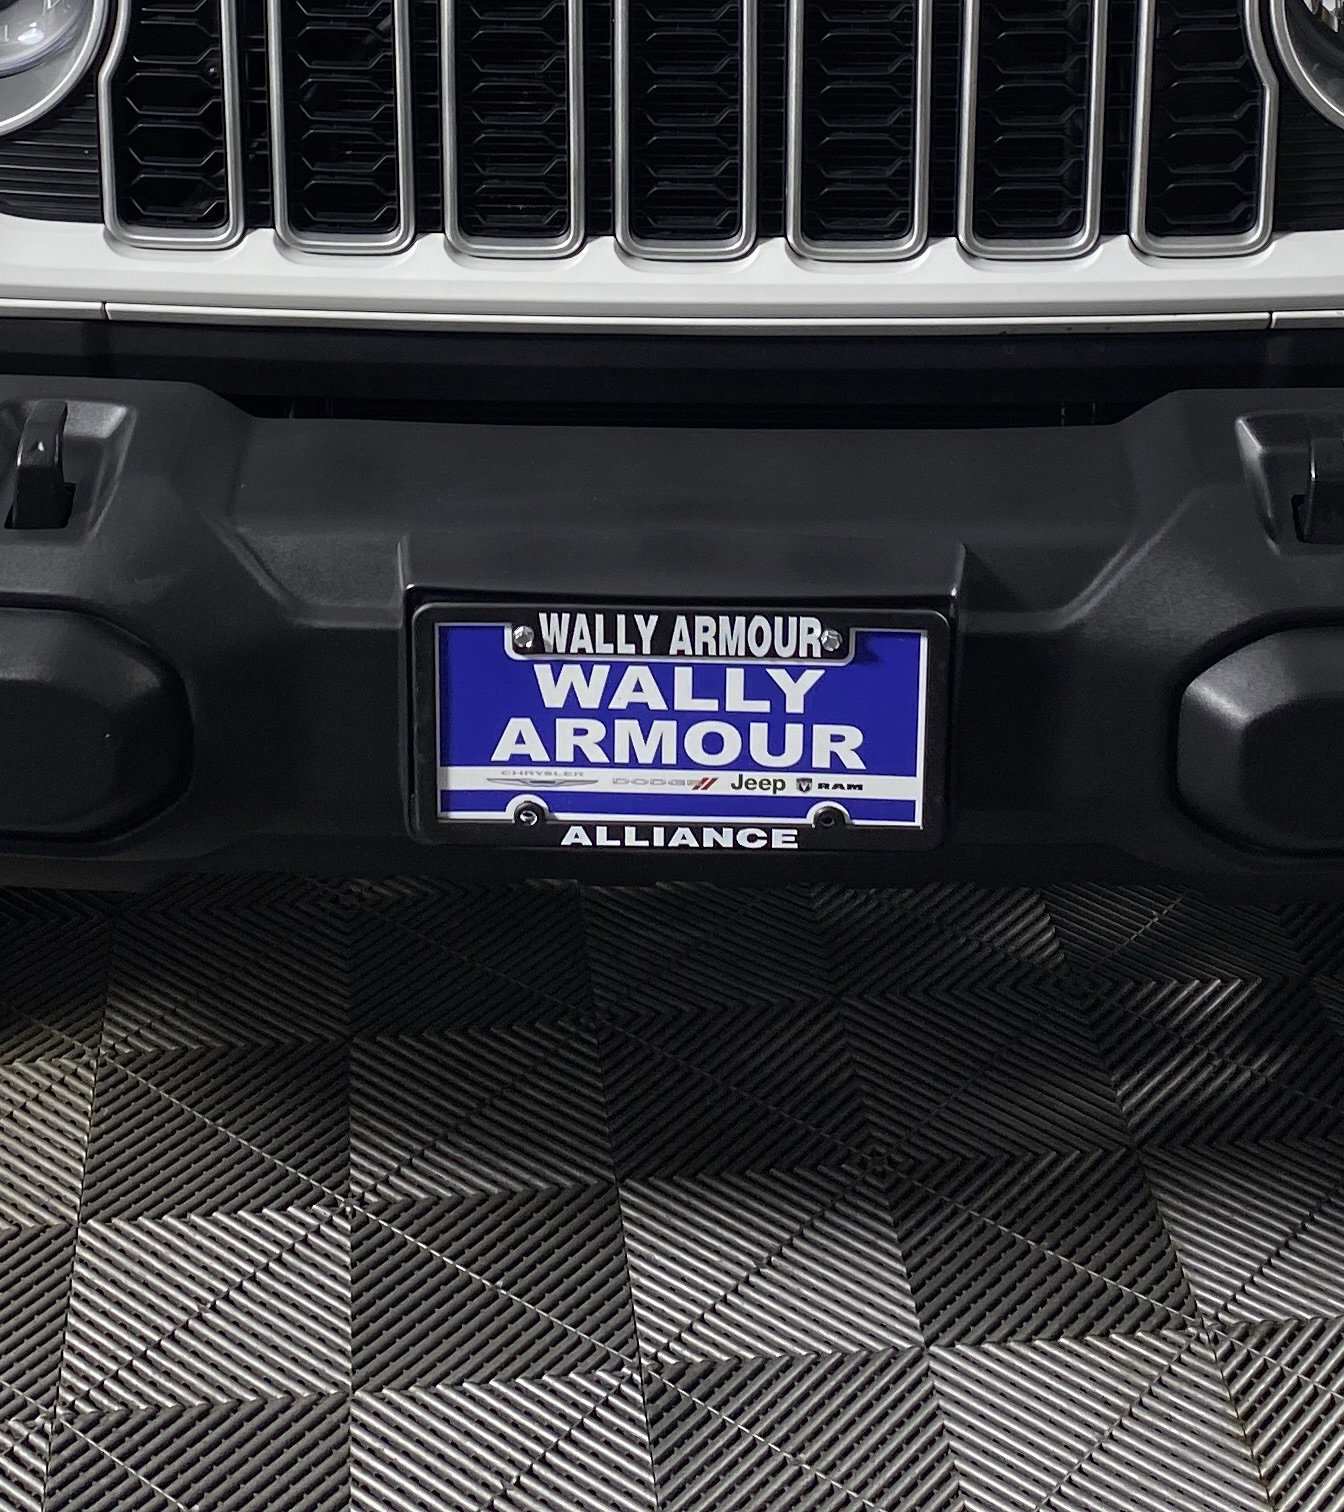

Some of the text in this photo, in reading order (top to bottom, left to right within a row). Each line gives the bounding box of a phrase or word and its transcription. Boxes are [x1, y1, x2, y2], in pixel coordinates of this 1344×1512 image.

[538, 612, 822, 659] WALLY ARMOUR
[533, 664, 826, 714] WALLY
[490, 717, 867, 770] ARMOUR
[500, 769, 585, 778] CHRYSLER
[731, 774, 786, 794] Jeep
[817, 782, 864, 792] RAM
[561, 826, 799, 850] ALLIANCE
